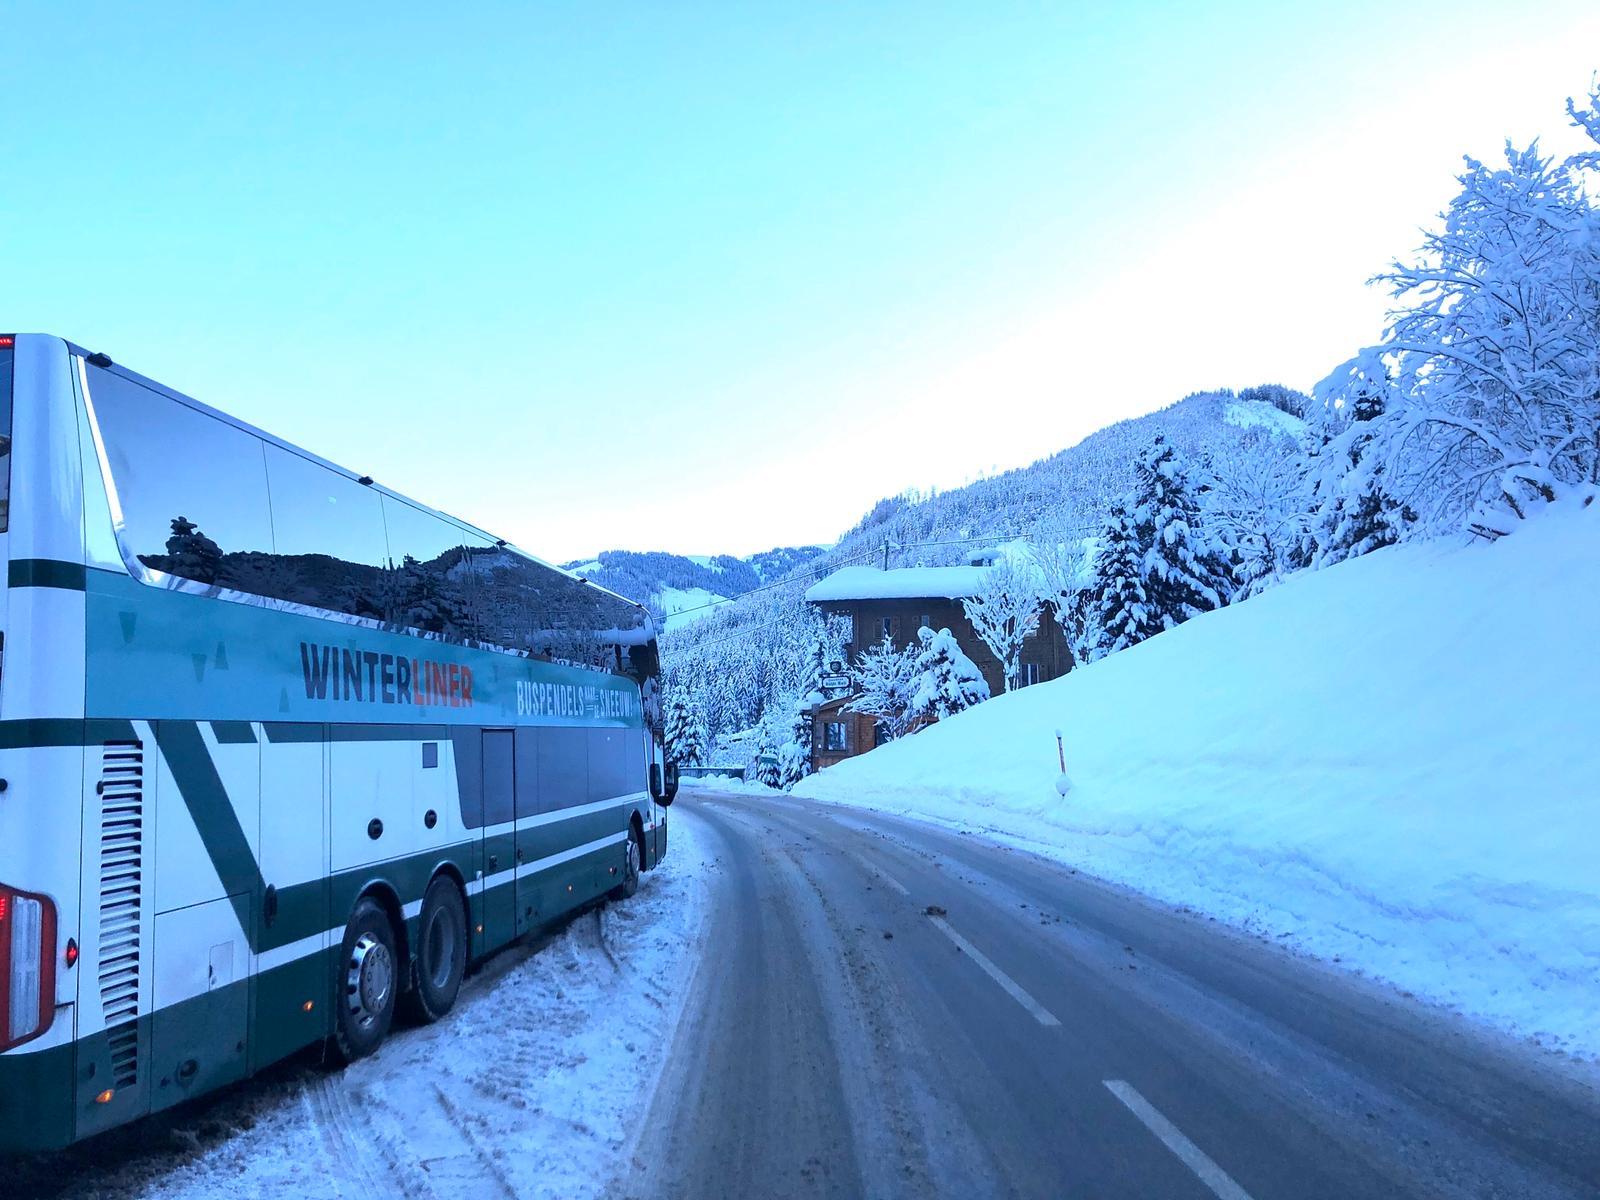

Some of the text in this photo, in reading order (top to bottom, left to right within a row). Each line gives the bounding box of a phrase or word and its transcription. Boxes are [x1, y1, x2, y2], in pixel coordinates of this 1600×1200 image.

[300, 642, 473, 707] WINTERLINER
[516, 680, 584, 717] BUSPENDELS
[600, 688, 633, 717] SNEEUW!
